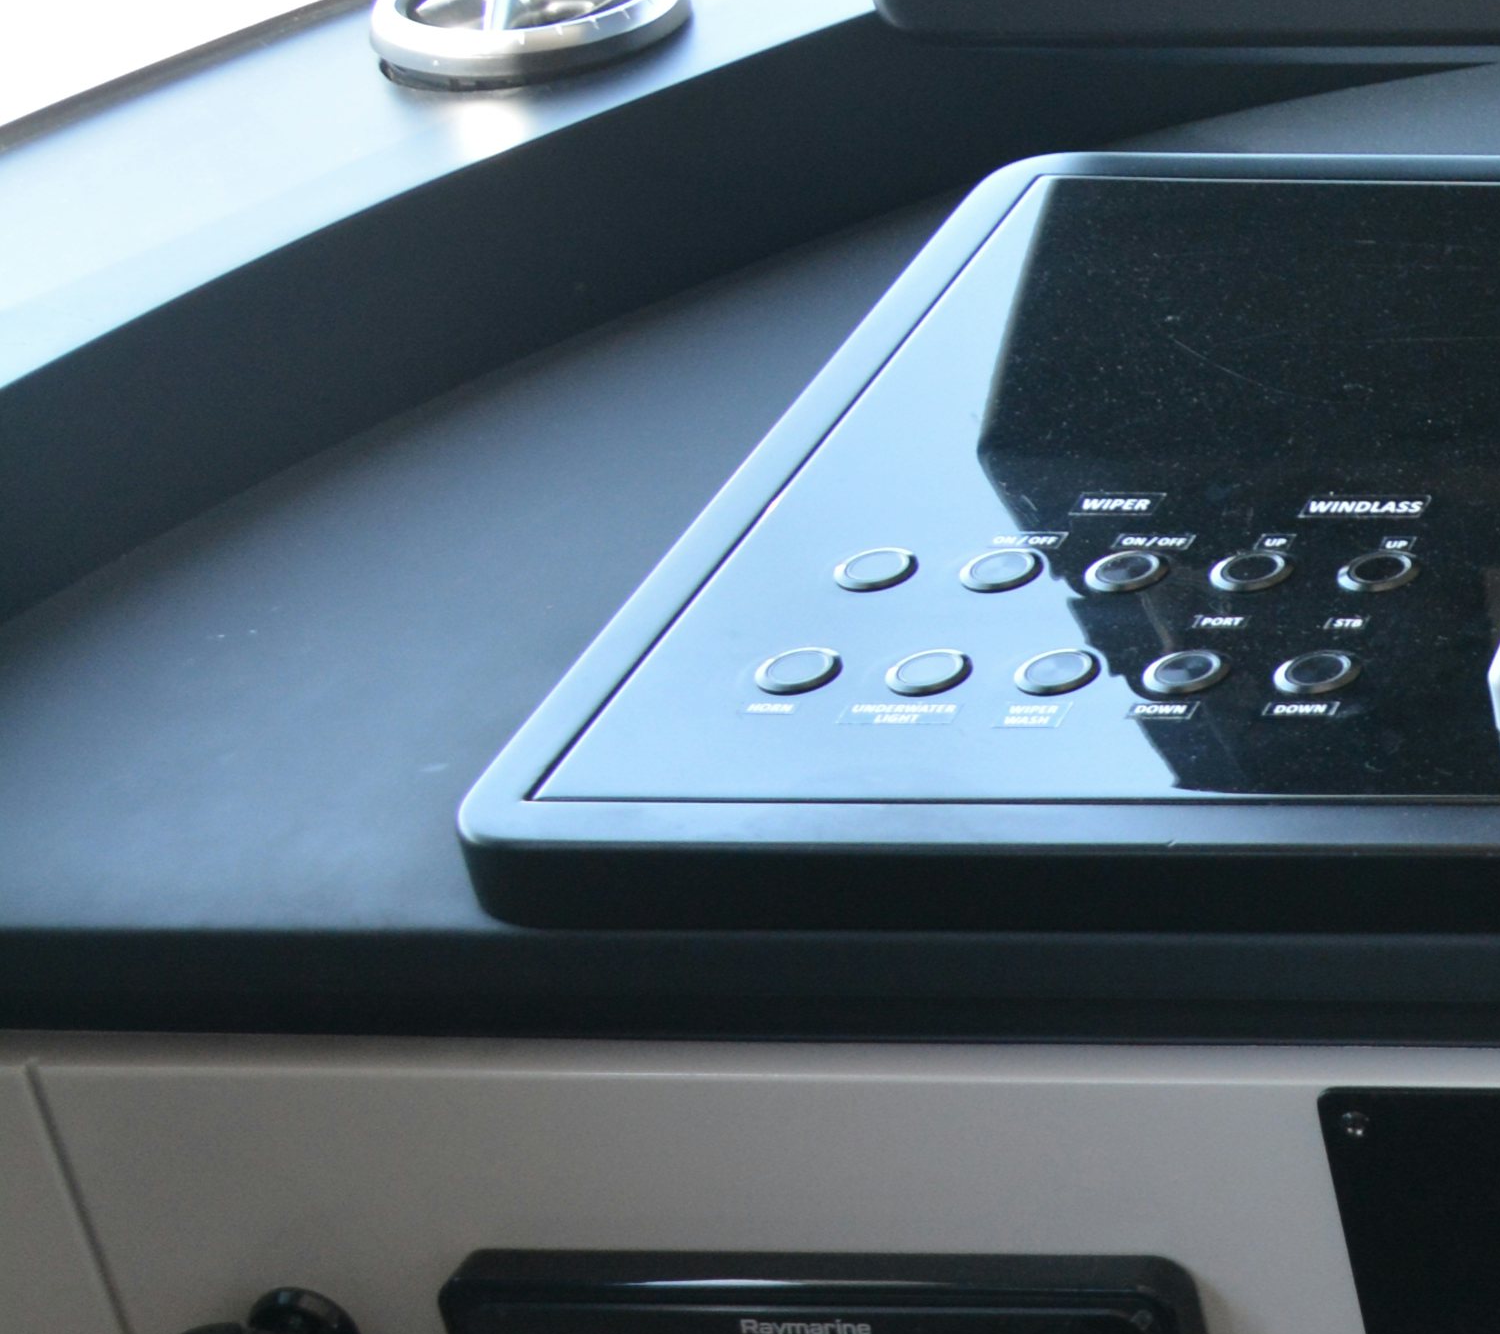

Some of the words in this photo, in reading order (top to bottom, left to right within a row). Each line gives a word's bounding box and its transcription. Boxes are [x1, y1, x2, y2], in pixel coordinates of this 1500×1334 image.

[1081, 497, 1151, 512] WIPER
[1309, 500, 1423, 514] WINDLASS
[993, 535, 1016, 546] ON
[1029, 535, 1059, 546] OFF
[1122, 536, 1146, 547] ON
[1159, 537, 1188, 547] OFF
[1264, 537, 1288, 548] UP
[1384, 540, 1408, 550] UP
[1201, 616, 1244, 627] PORT
[1333, 617, 1362, 628] STB
[747, 703, 795, 714] HORN
[852, 703, 957, 714] UNDERWATER
[1009, 704, 1059, 715] WIPER
[1134, 704, 1188, 715] DOWN
[1273, 704, 1328, 715] DOWN
